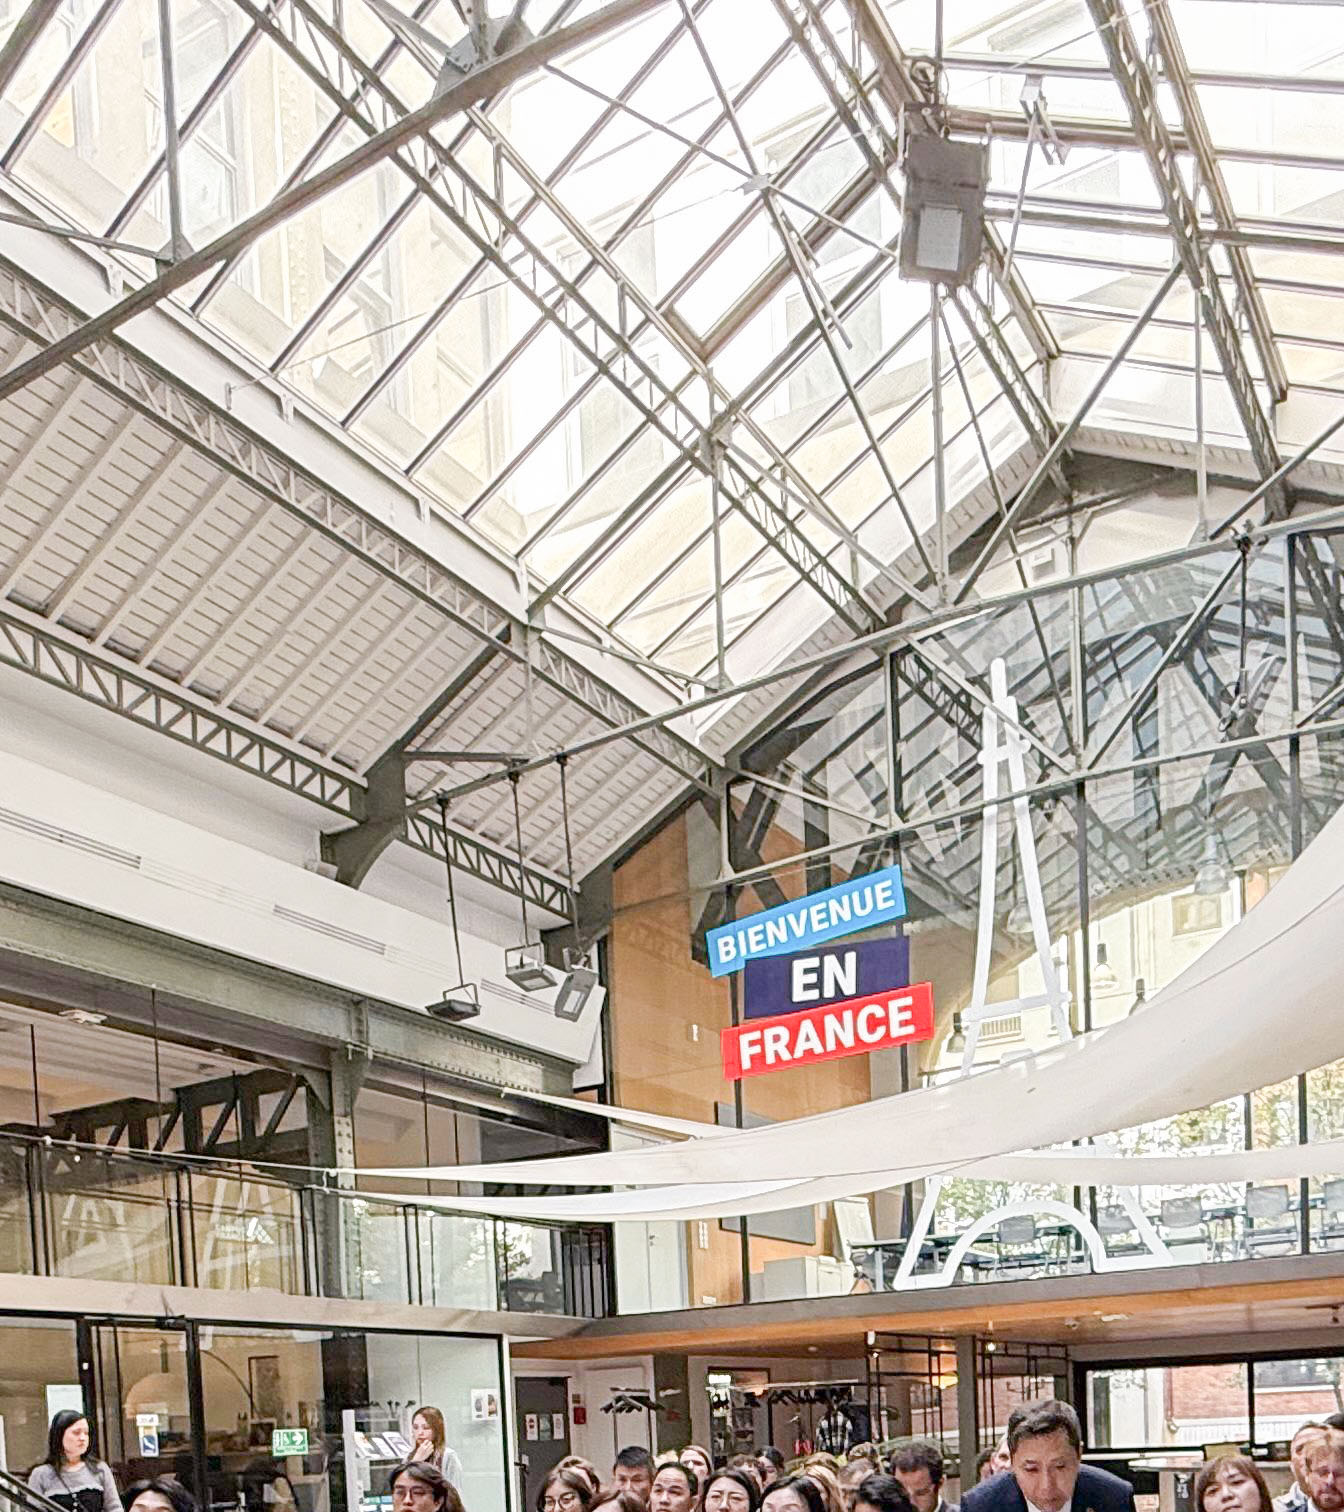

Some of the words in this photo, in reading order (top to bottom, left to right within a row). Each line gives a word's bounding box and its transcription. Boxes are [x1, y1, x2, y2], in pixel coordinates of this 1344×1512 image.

[717, 879, 896, 963] BIENVENUE
[791, 951, 857, 1003] EN
[739, 996, 915, 1071] FRANCE
